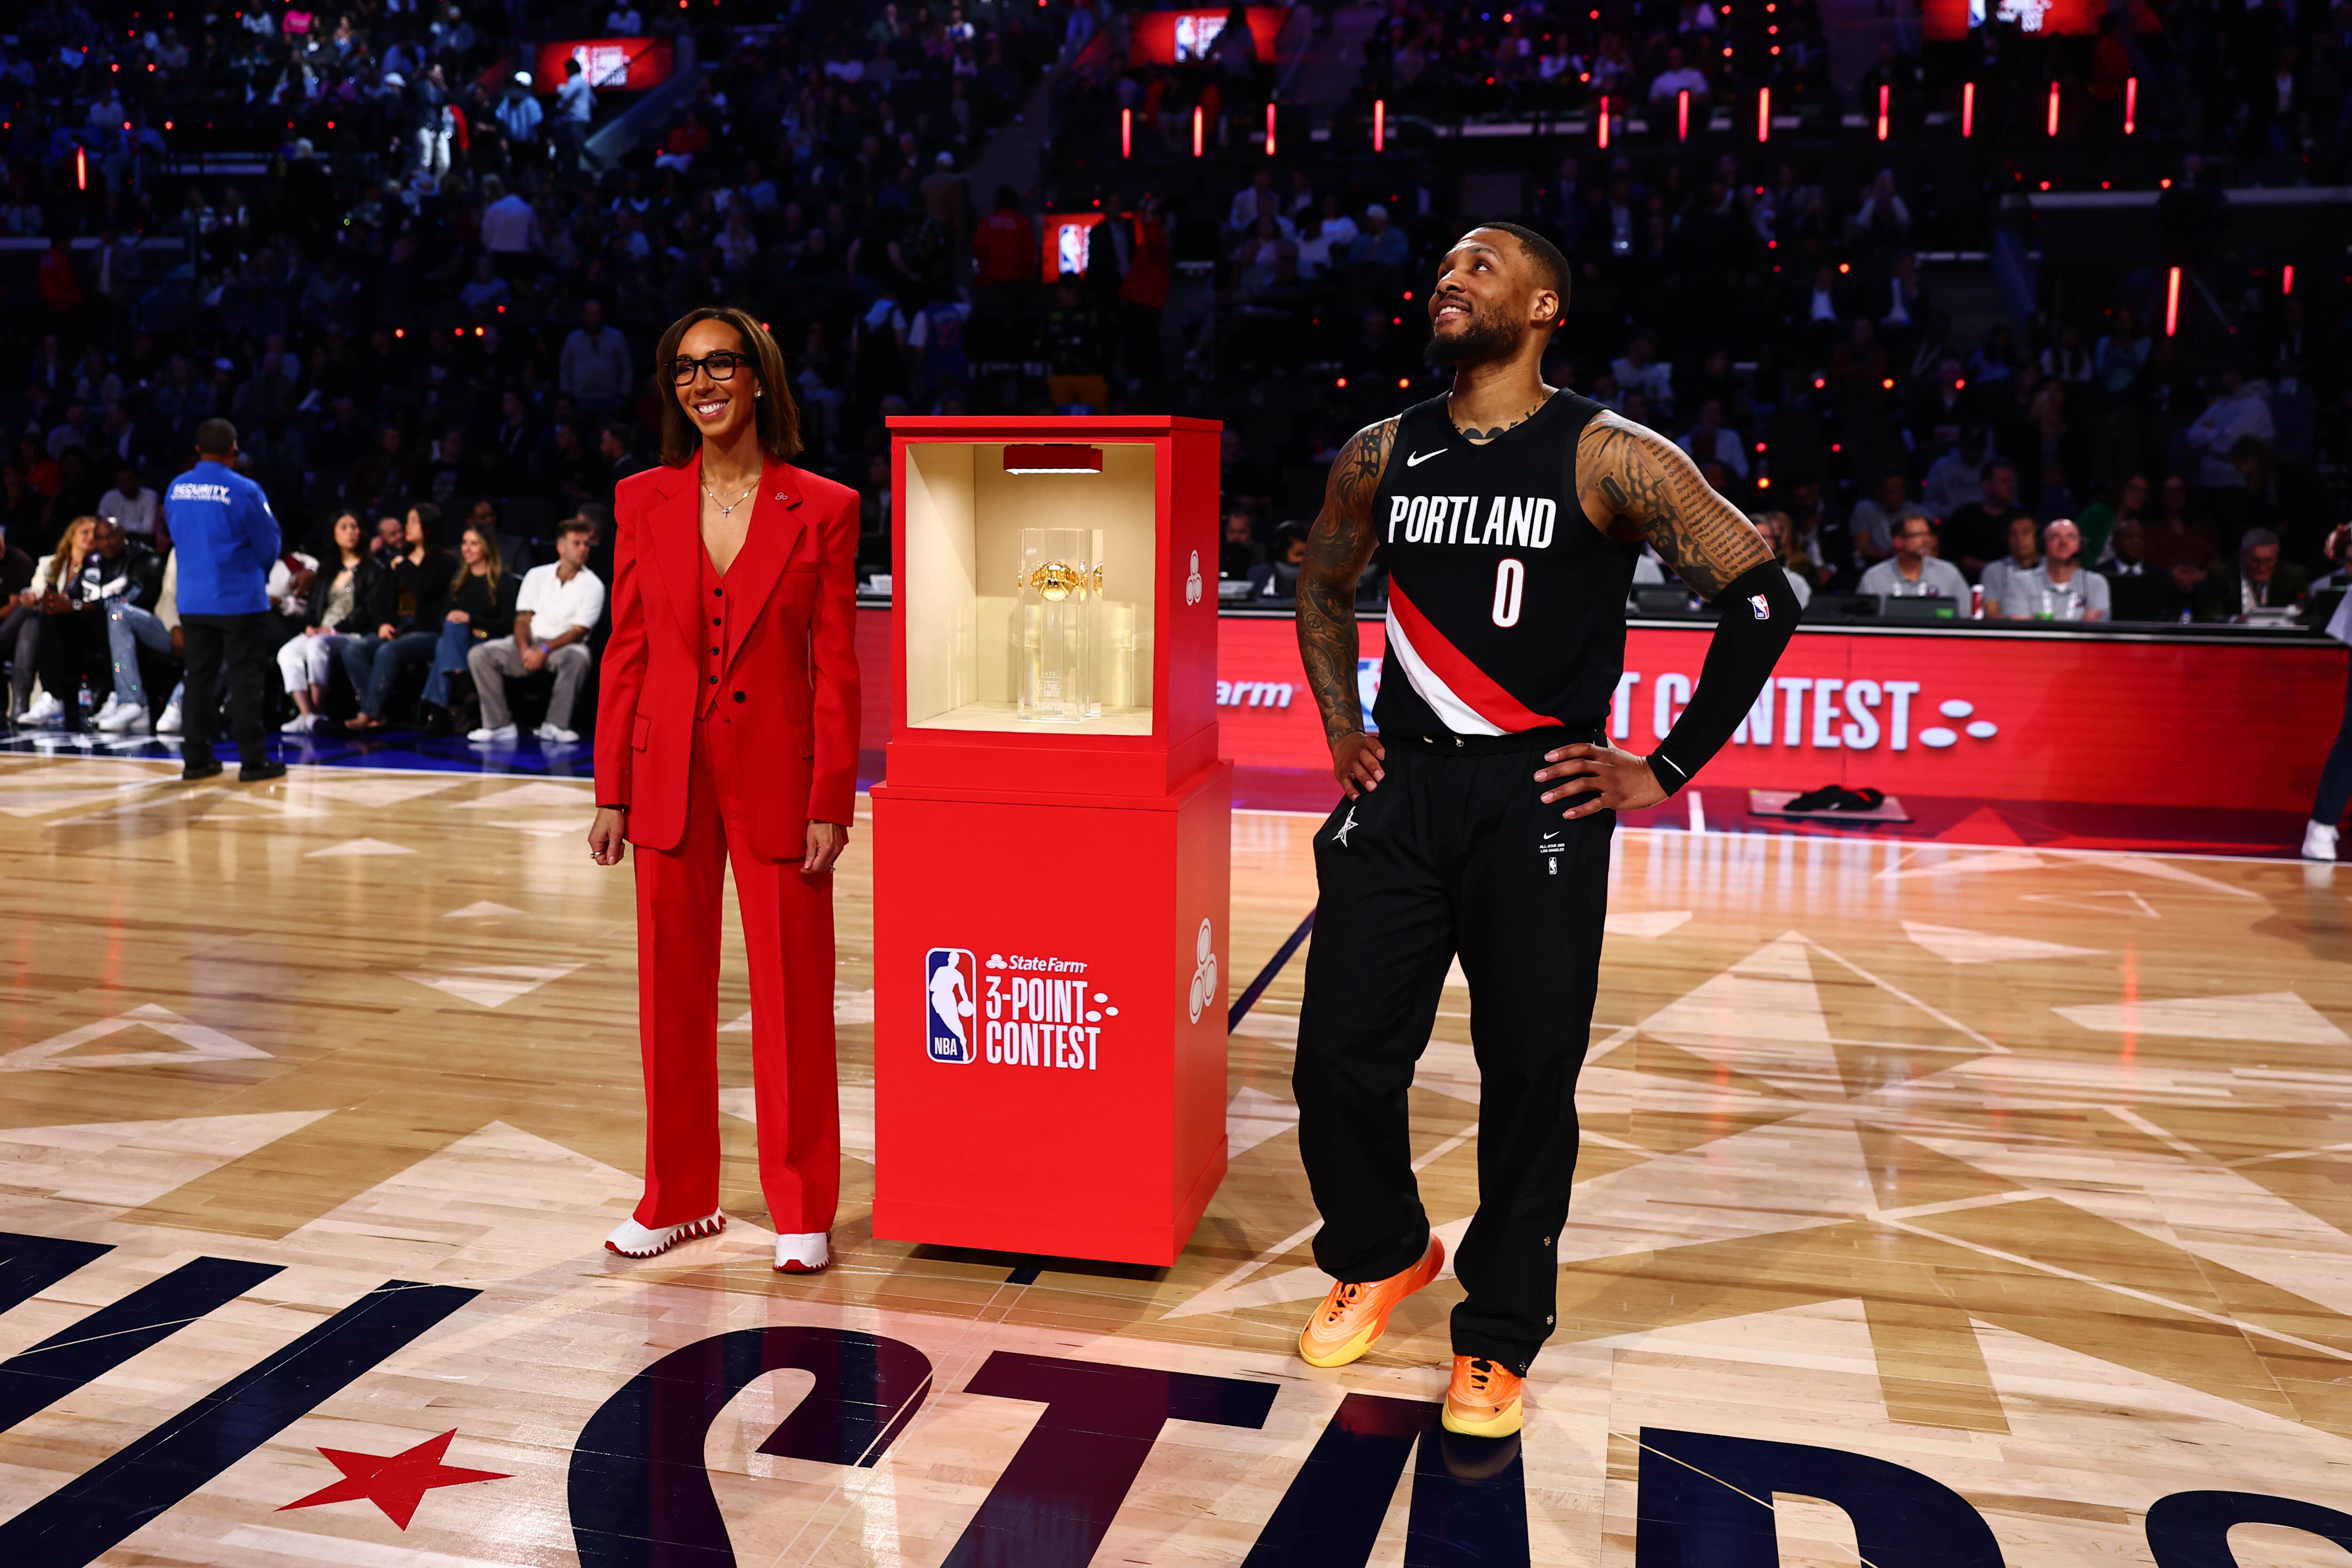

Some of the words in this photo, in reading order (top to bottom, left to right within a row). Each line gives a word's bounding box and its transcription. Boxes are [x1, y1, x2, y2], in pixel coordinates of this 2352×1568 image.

[1388, 495, 1556, 549] PORTLAND
[1492, 557, 1526, 628] 0
[1216, 680, 1294, 708] arm
[1653, 672, 1920, 750] CNTEST
[985, 976, 1088, 1024] 3-POINT
[934, 1037, 958, 1056] NBA
[986, 1020, 1101, 1070] CONTEST
